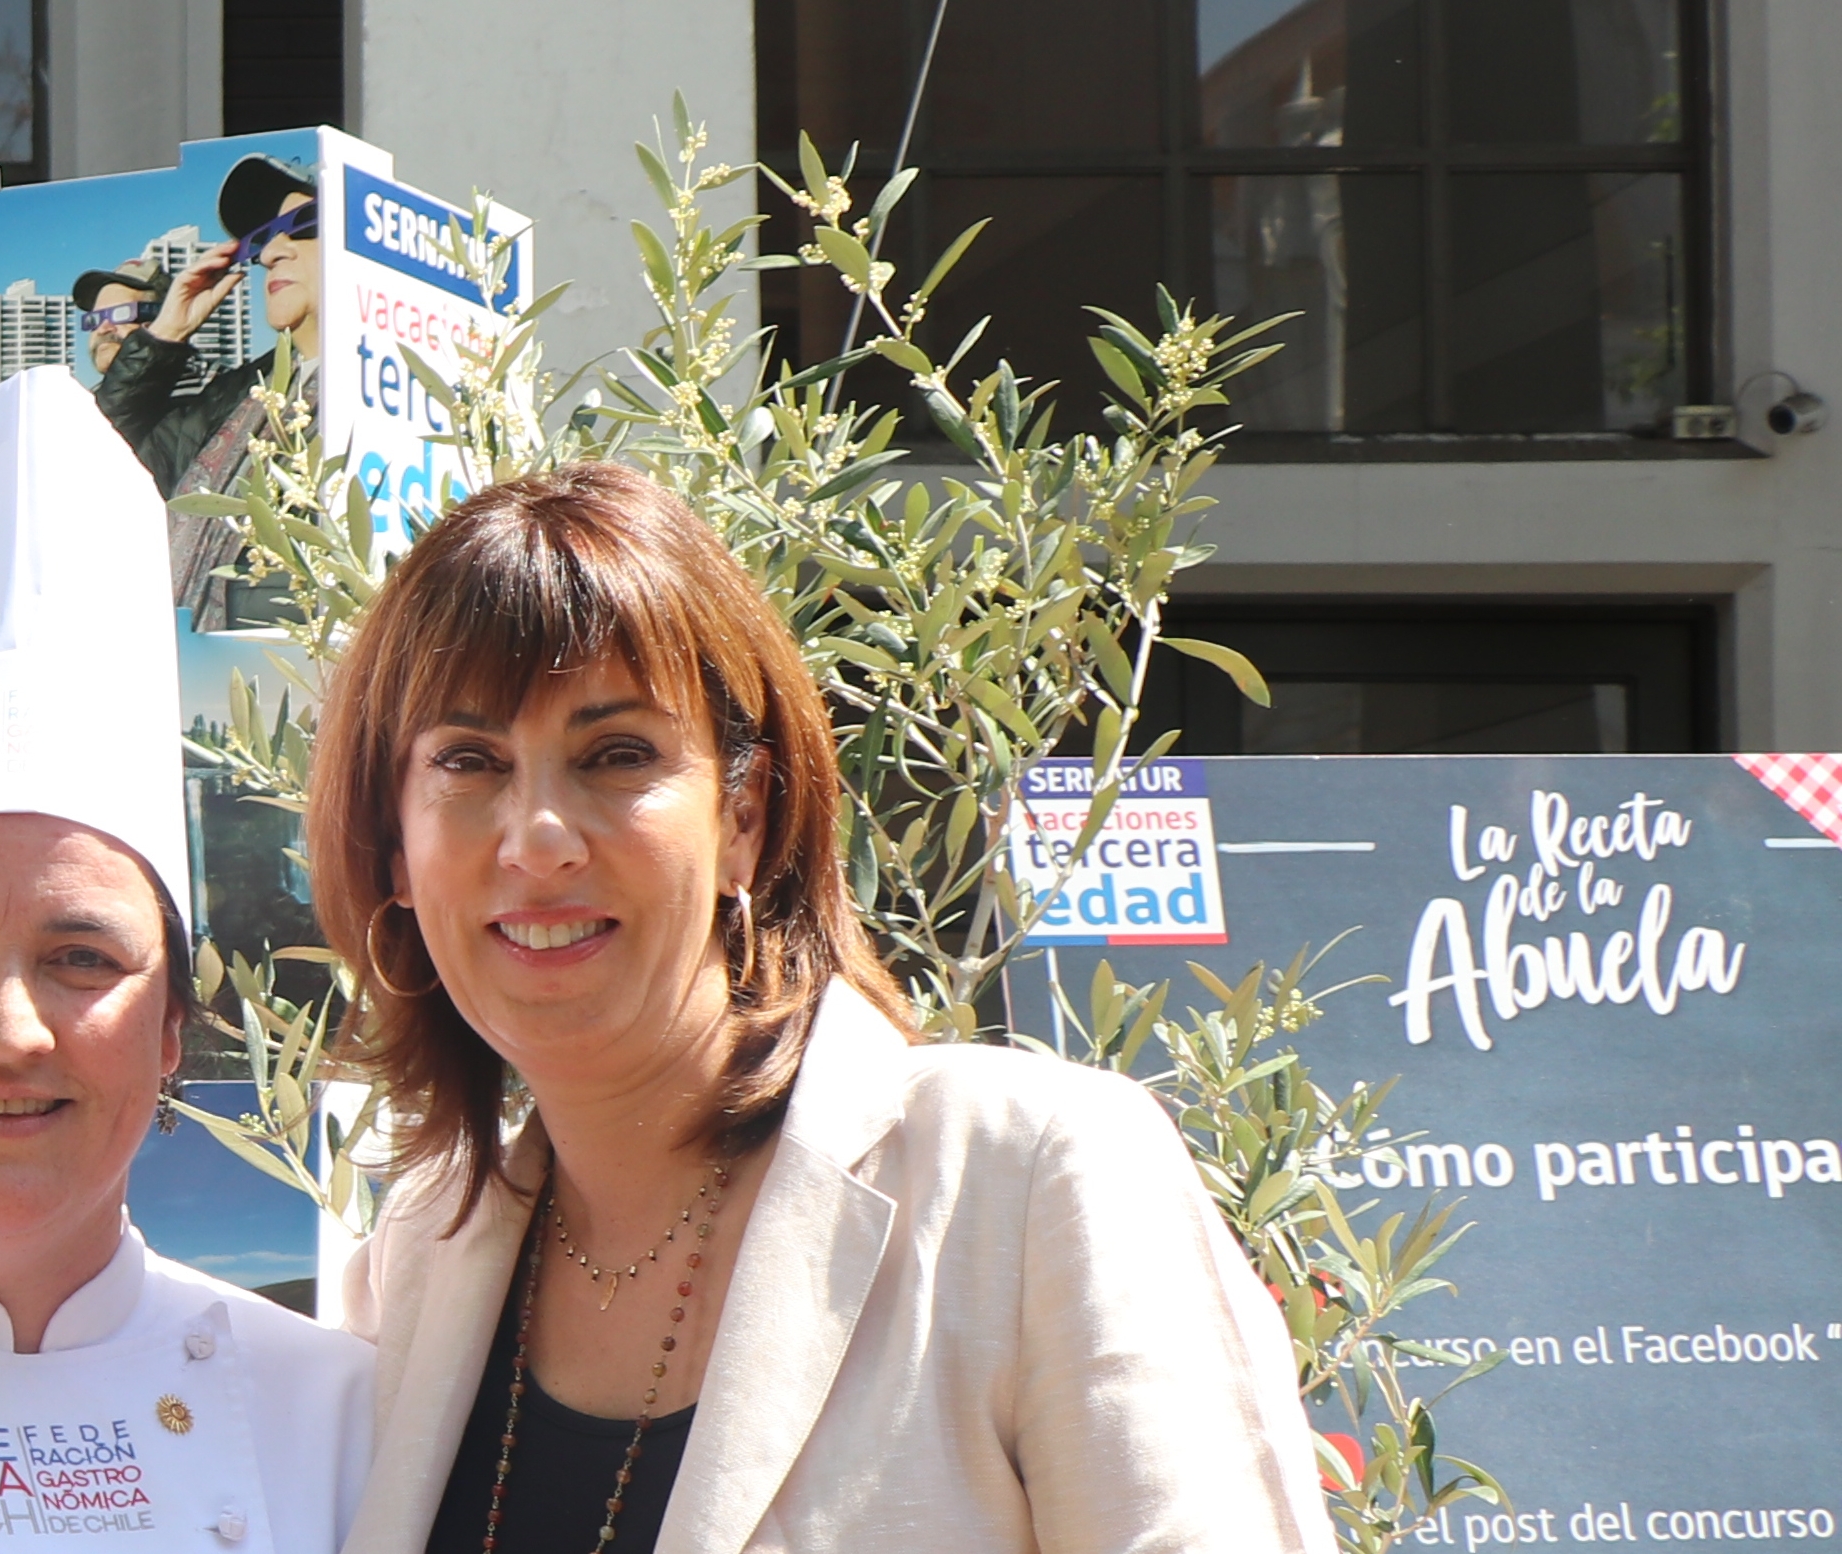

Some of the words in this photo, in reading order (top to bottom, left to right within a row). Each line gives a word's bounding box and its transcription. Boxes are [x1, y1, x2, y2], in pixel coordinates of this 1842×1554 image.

[1450, 804, 1518, 882] La
[1530, 789, 1692, 877] Receta
[1035, 872, 1208, 926] edad
[1519, 862, 1568, 922] de
[1578, 861, 1624, 914] la
[1388, 874, 1747, 1052] Abuela
[1533, 1124, 1842, 1201] participa
[1509, 1335, 1562, 1366] en
[1574, 1326, 1613, 1365] el
[1621, 1323, 1820, 1364] Facebook
[36, 1464, 142, 1488] GASTRO
[1414, 1505, 1455, 1545] el
[1465, 1508, 1559, 1554] post
[1569, 1502, 1638, 1541] del
[1646, 1507, 1835, 1541] concurso
